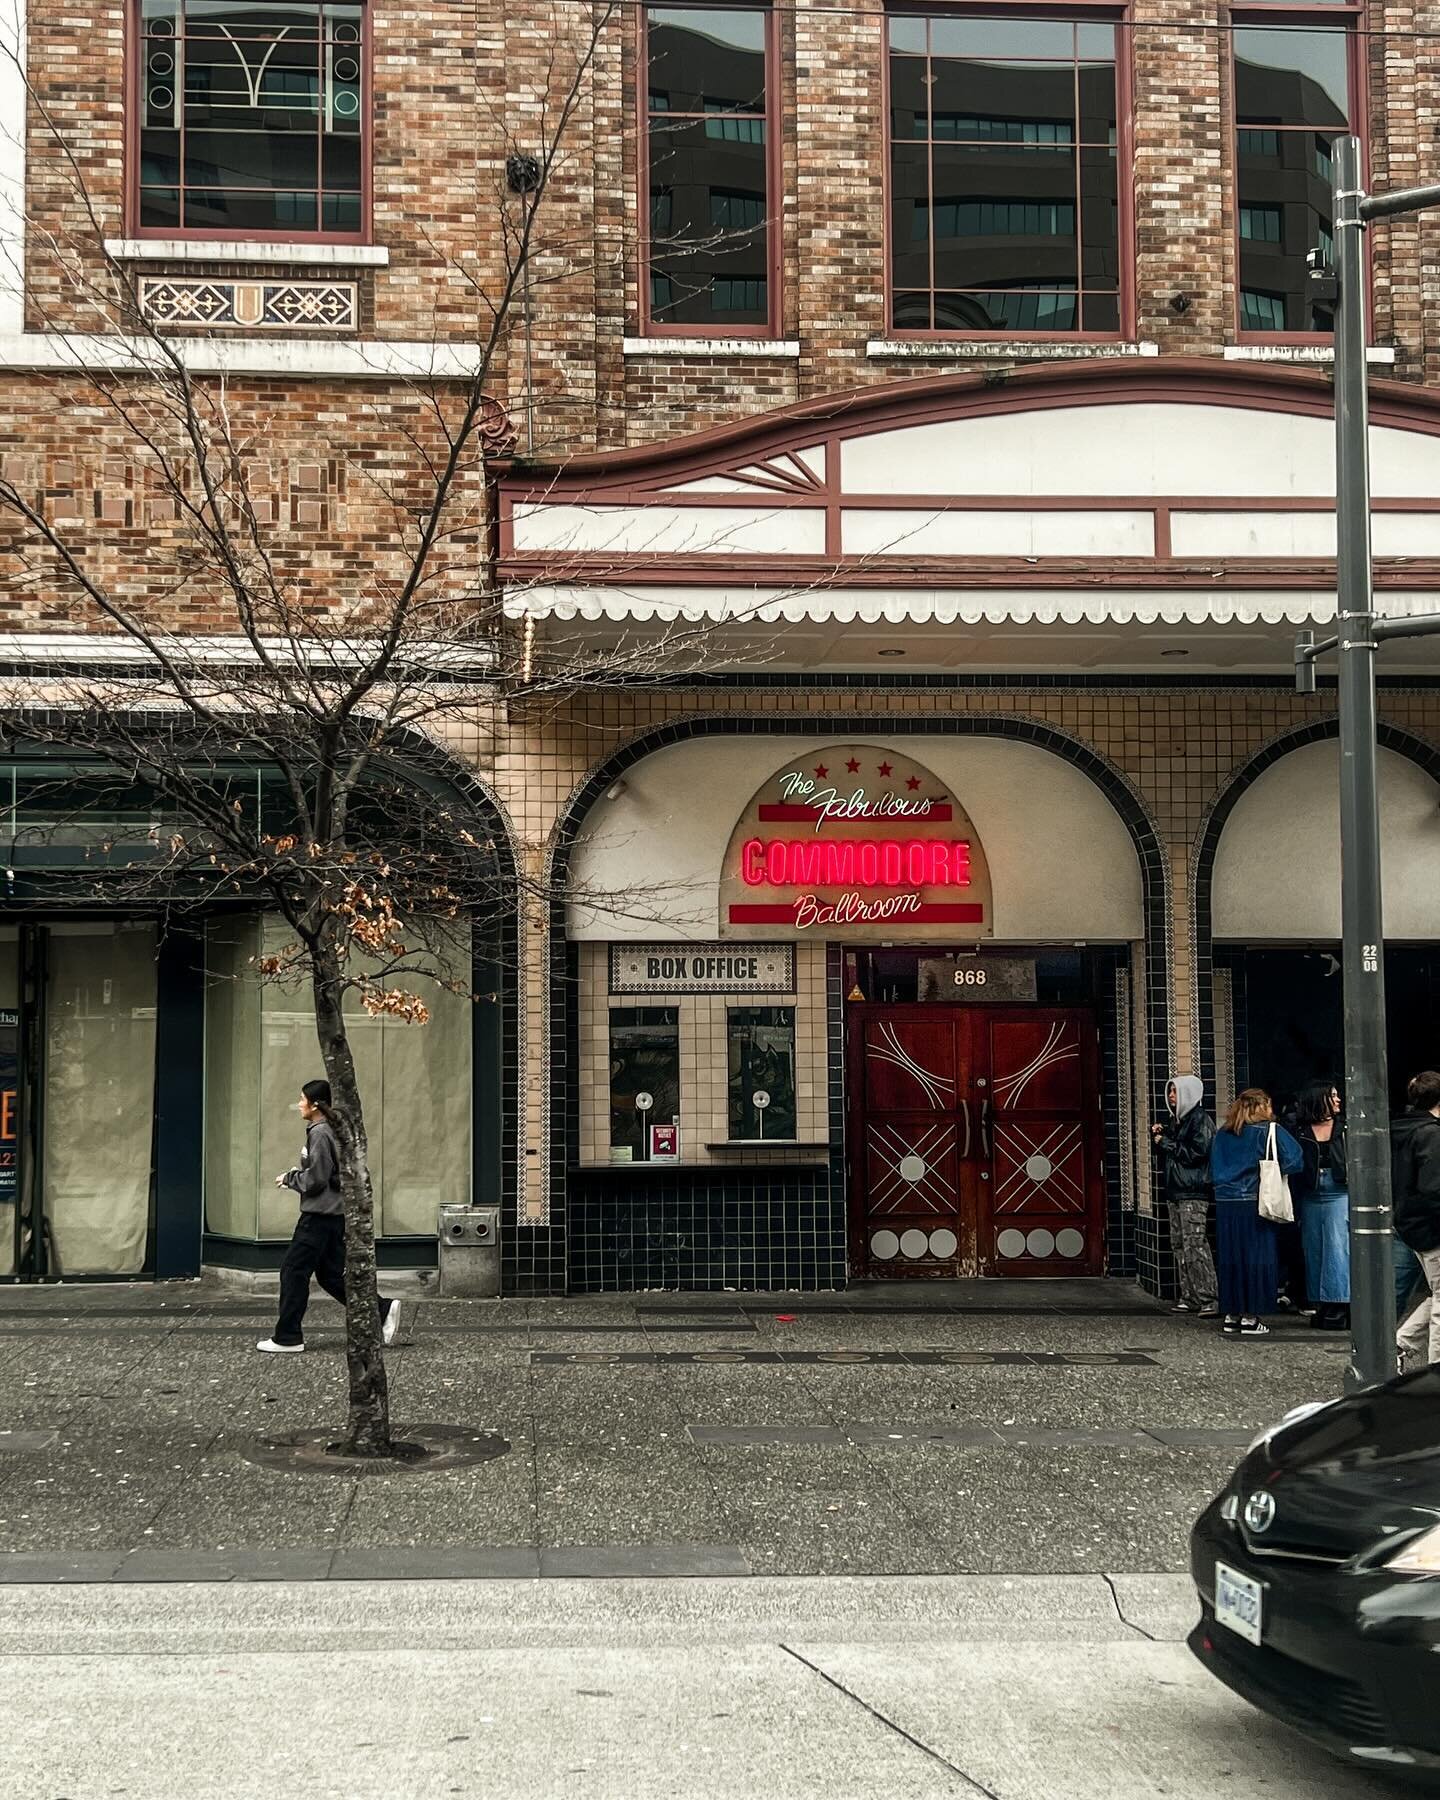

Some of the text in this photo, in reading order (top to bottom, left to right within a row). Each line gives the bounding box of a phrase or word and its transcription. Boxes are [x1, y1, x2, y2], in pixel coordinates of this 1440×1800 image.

[779, 772, 815, 800] The
[805, 788, 935, 832] Fabulous
[743, 839, 970, 886] COMMODORE
[793, 892, 922, 929] Ballroom
[1362, 945, 1377, 957] 22
[647, 957, 758, 979] BOX OFFICE
[953, 970, 987, 986] 868
[1363, 960, 1378, 972] 08
